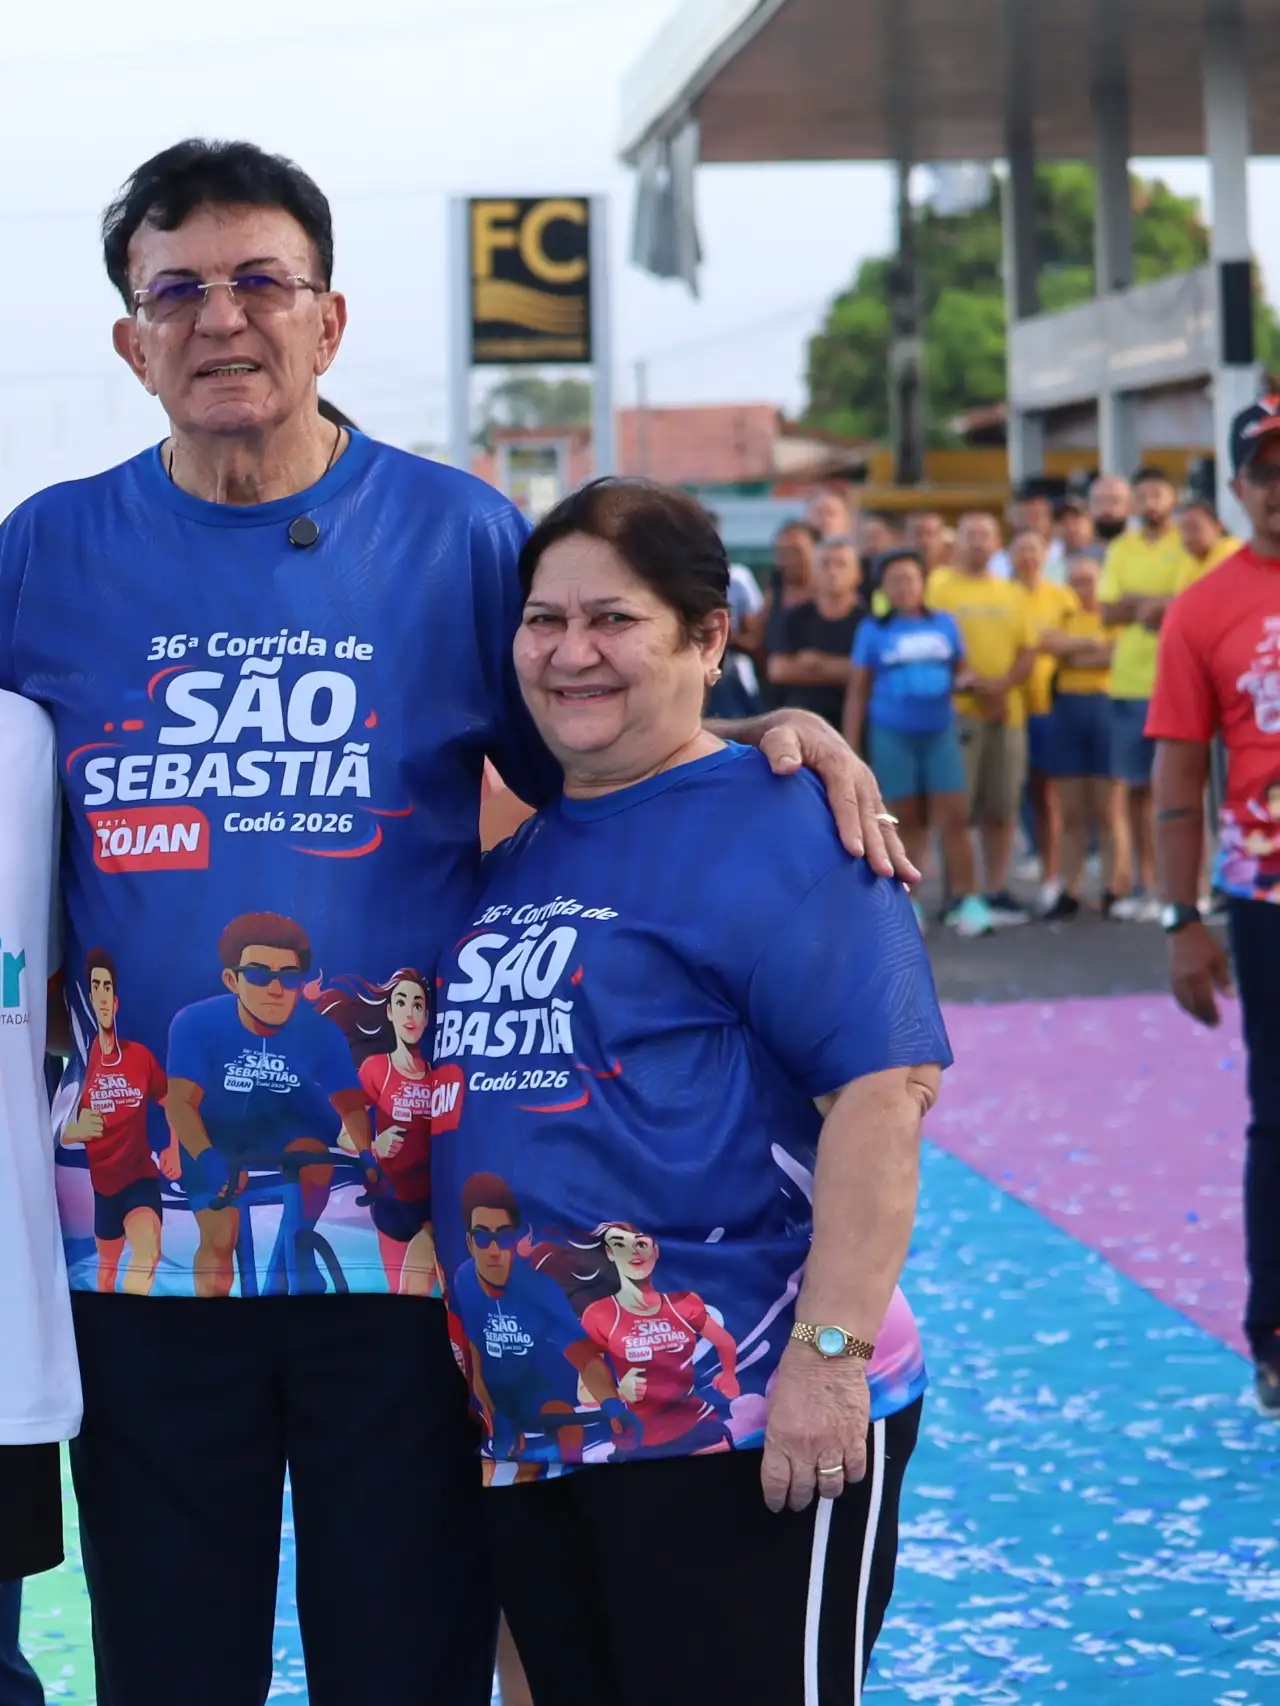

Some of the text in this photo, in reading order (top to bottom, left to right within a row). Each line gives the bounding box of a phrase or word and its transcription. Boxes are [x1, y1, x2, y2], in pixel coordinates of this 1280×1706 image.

[473, 199, 587, 285] FC
[147, 629, 374, 661] 36ª Corrida de
[158, 656, 357, 746] SÃO
[83, 742, 372, 806] SEBASTIÃ
[97, 818, 127, 827] DATA
[223, 811, 354, 833] Codó 2026
[473, 896, 619, 926] 36ª Corrida de
[447, 921, 577, 1003] SÃO
[243, 1053, 285, 1072] SÃO
[98, 1076, 128, 1090] SÃO
[226, 1065, 298, 1084] SEBASTIÃO
[226, 1079, 252, 1089] 20JAN
[469, 1070, 571, 1092] Codó 2026
[90, 1087, 141, 1100] SEBASTIÃO
[402, 1085, 431, 1099] SÃO
[491, 1317, 518, 1333] SÃO
[638, 1320, 671, 1336] SÃO
[485, 1331, 531, 1344] SEBASTIÃO
[625, 1331, 686, 1347] SEBASTIÃO
